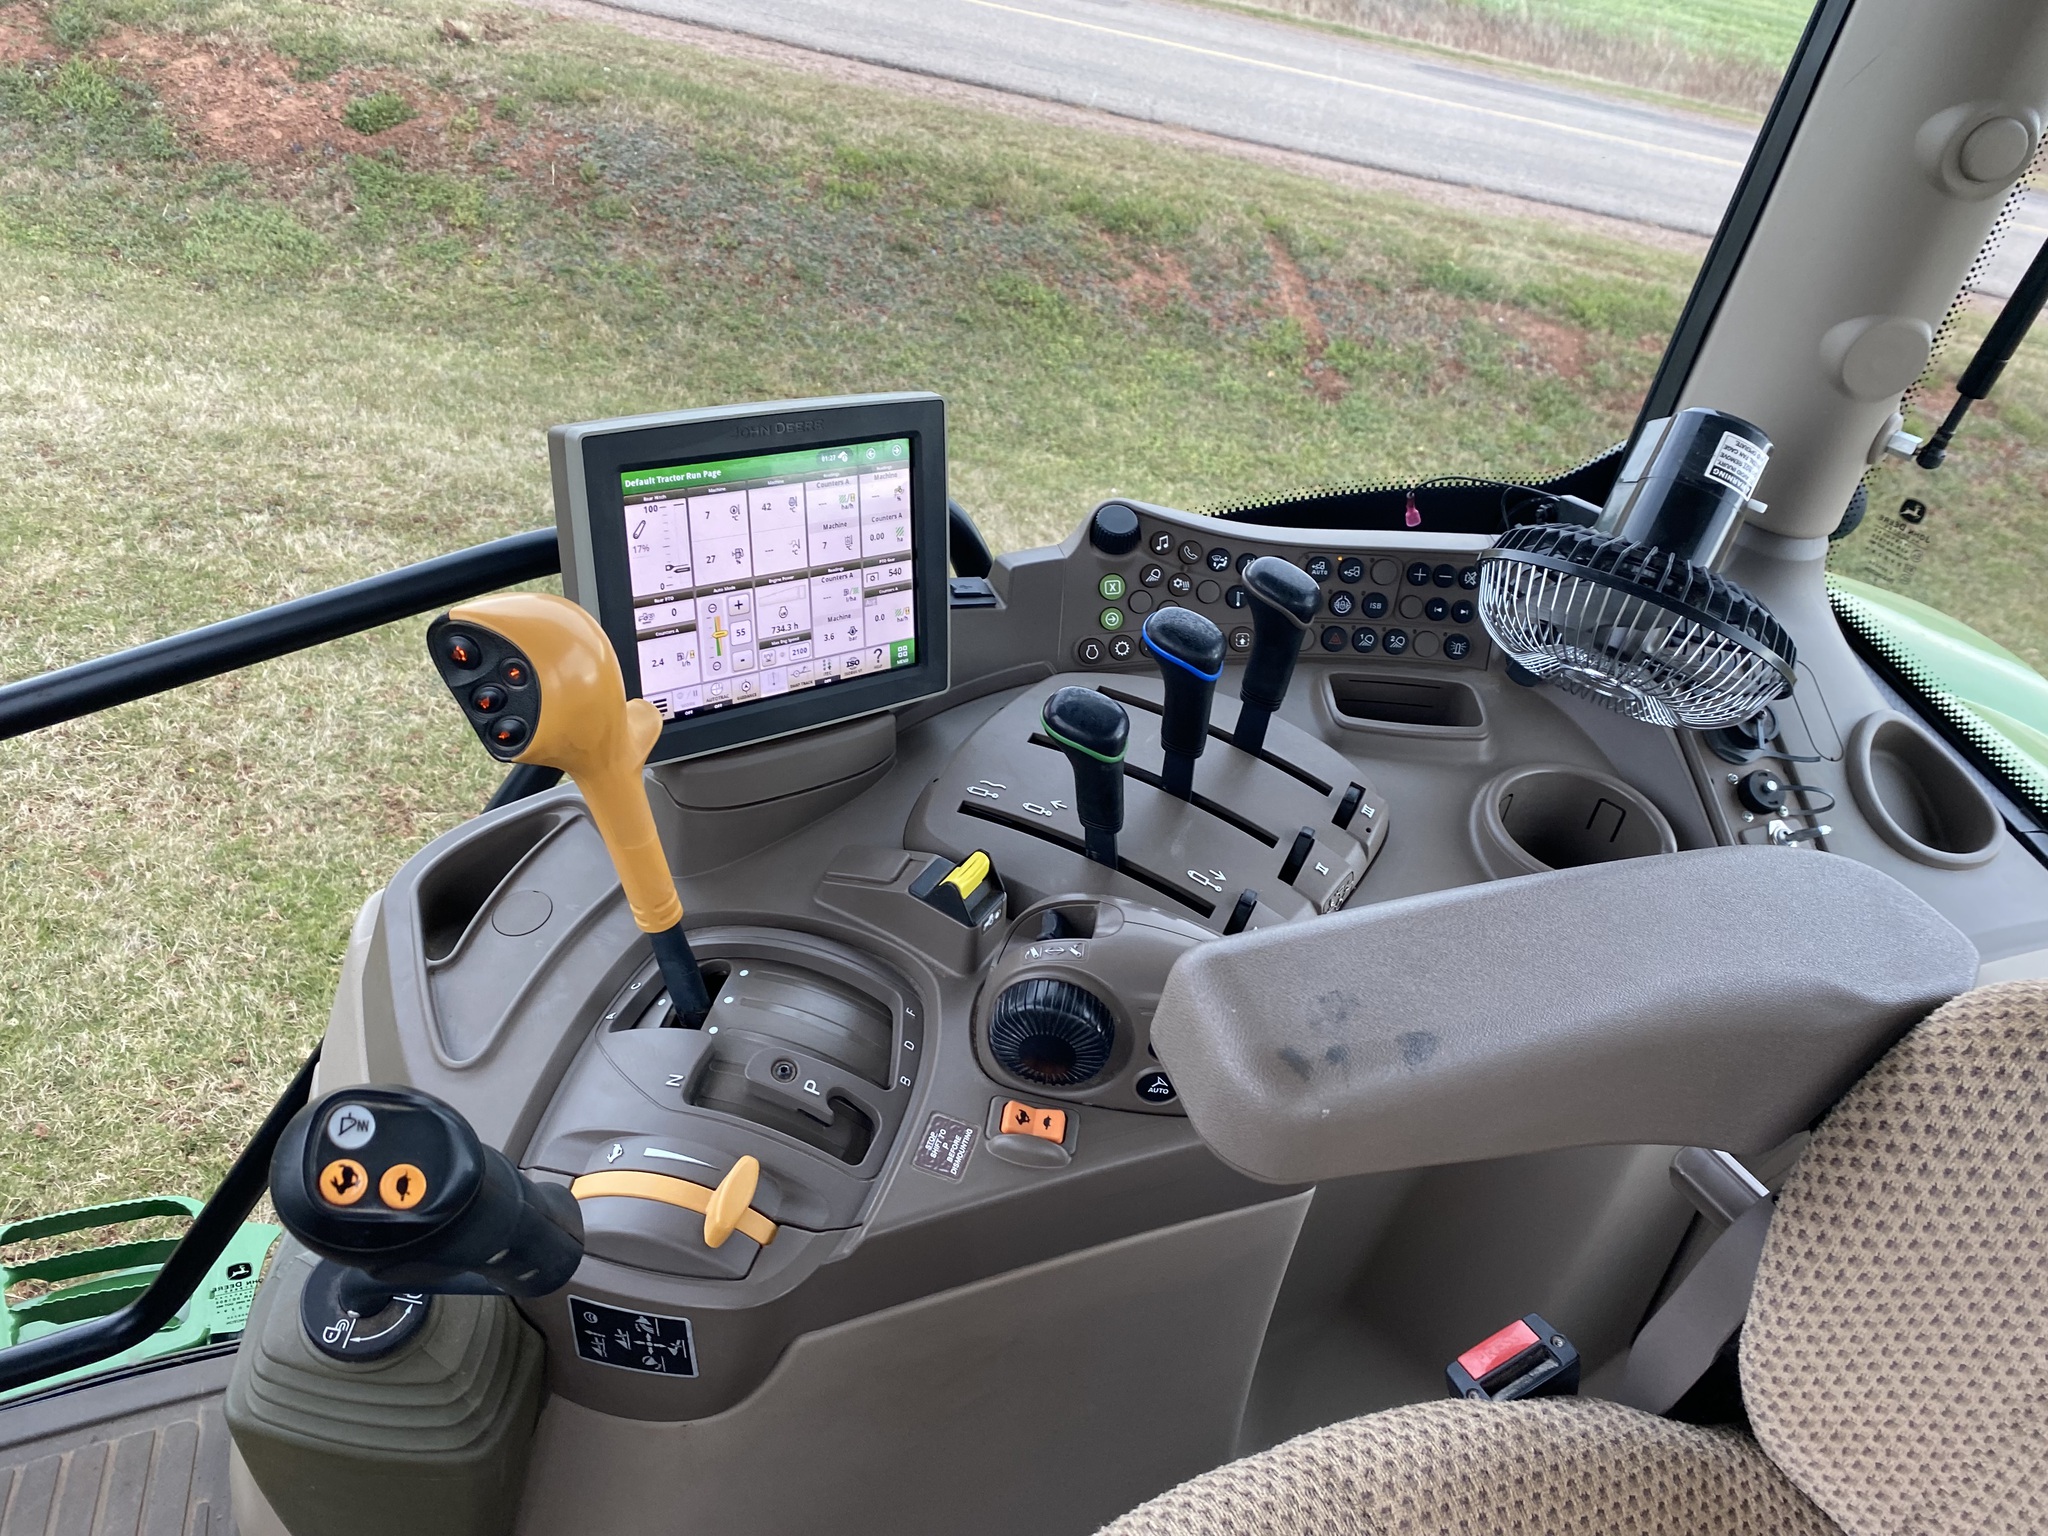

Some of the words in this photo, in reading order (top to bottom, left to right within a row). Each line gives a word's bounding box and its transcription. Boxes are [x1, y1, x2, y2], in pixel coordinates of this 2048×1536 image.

[732, 425, 771, 439] JOHN
[775, 419, 824, 434] DEERE
[625, 477, 656, 488] Default
[656, 475, 685, 484] Tractor
[686, 472, 702, 480] Run
[703, 470, 721, 479] Page
[874, 472, 898, 480] Machine
[816, 479, 844, 489] Counters
[644, 505, 658, 513] 100
[761, 503, 772, 511] 42
[705, 511, 710, 519] 7
[871, 514, 897, 523] Counters
[823, 522, 847, 530] Machine
[870, 533, 885, 541] 0.00
[633, 544, 650, 554] 17%
[706, 555, 716, 564] 27
[888, 567, 902, 577] 540
[821, 574, 848, 583] Counters
[1109, 583, 1116, 592] X
[671, 608, 677, 616] 0
[828, 614, 851, 622] Machine
[875, 614, 885, 622] 0.0
[736, 628, 746, 637] 55
[771, 623, 792, 634] 734.3
[794, 622, 799, 630] h
[824, 633, 835, 641] 3.6
[792, 647, 808, 656] 2100
[651, 658, 665, 668] 2.4
[846, 660, 860, 668] ISO
[706, 694, 730, 703] AUTOTRAC
[631, 982, 641, 990] C
[605, 1012, 617, 1020] A
[905, 1007, 916, 1017] F
[904, 1040, 915, 1051] D
[665, 1074, 684, 1087] N
[900, 1075, 911, 1087] B
[804, 1080, 820, 1096] P
[1148, 1087, 1169, 1095] AUTO
[925, 1132, 936, 1150] STOP
[930, 1138, 943, 1159] SHIFT
[938, 1129, 946, 1139] TO
[942, 1142, 949, 1150] P
[946, 1135, 962, 1163] BEFORE
[950, 1128, 973, 1175] DISMOUNTING
